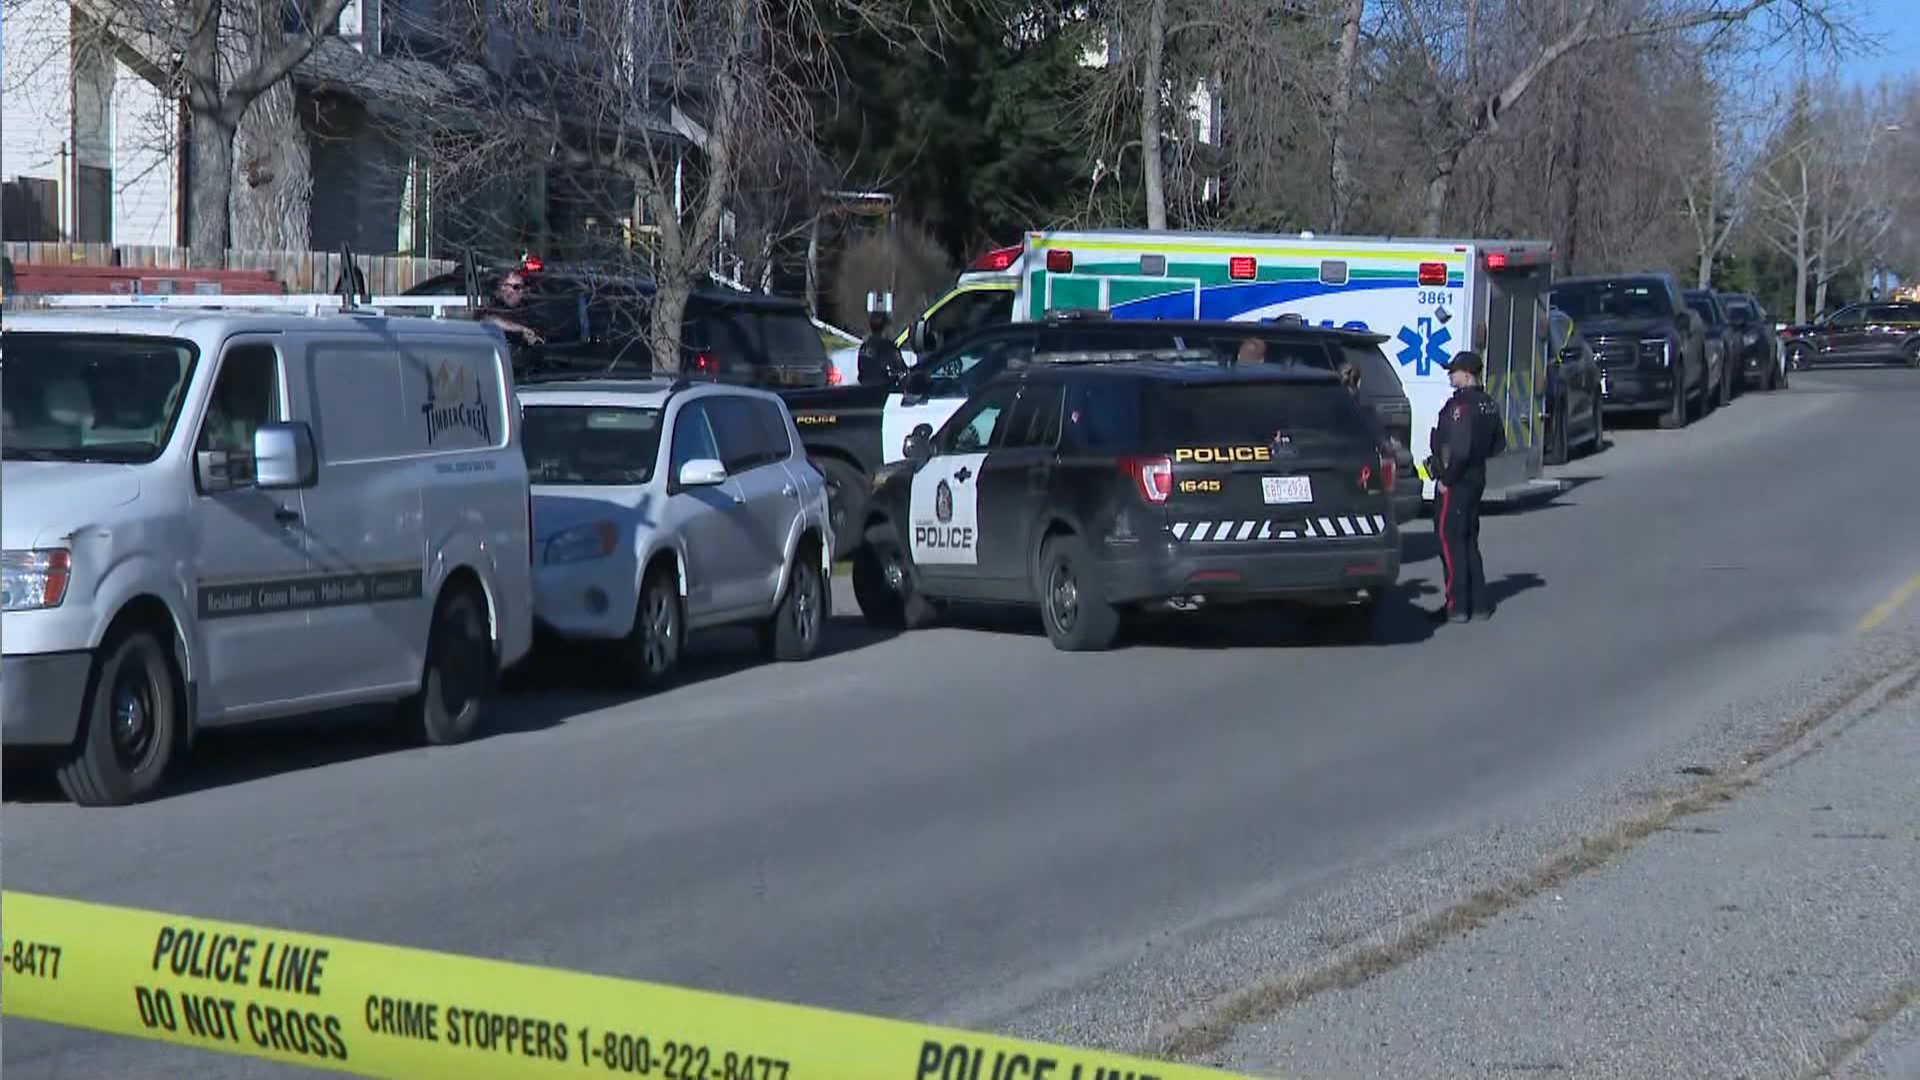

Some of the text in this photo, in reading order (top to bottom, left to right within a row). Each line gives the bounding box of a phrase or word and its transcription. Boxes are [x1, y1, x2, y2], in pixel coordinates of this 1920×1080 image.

[1418, 291, 1453, 305] 3861
[796, 415, 837, 424] POLICE
[1175, 447, 1271, 462] POLICE
[1179, 480, 1221, 493] 1645
[915, 527, 972, 548] POLICE
[207, 590, 252, 611] Residential
[152, 926, 329, 997] POLICE LINE
[135, 985, 348, 1061] DO NOT CROSS
[365, 994, 439, 1042] CRIME
[446, 1006, 569, 1063] STOPPERS
